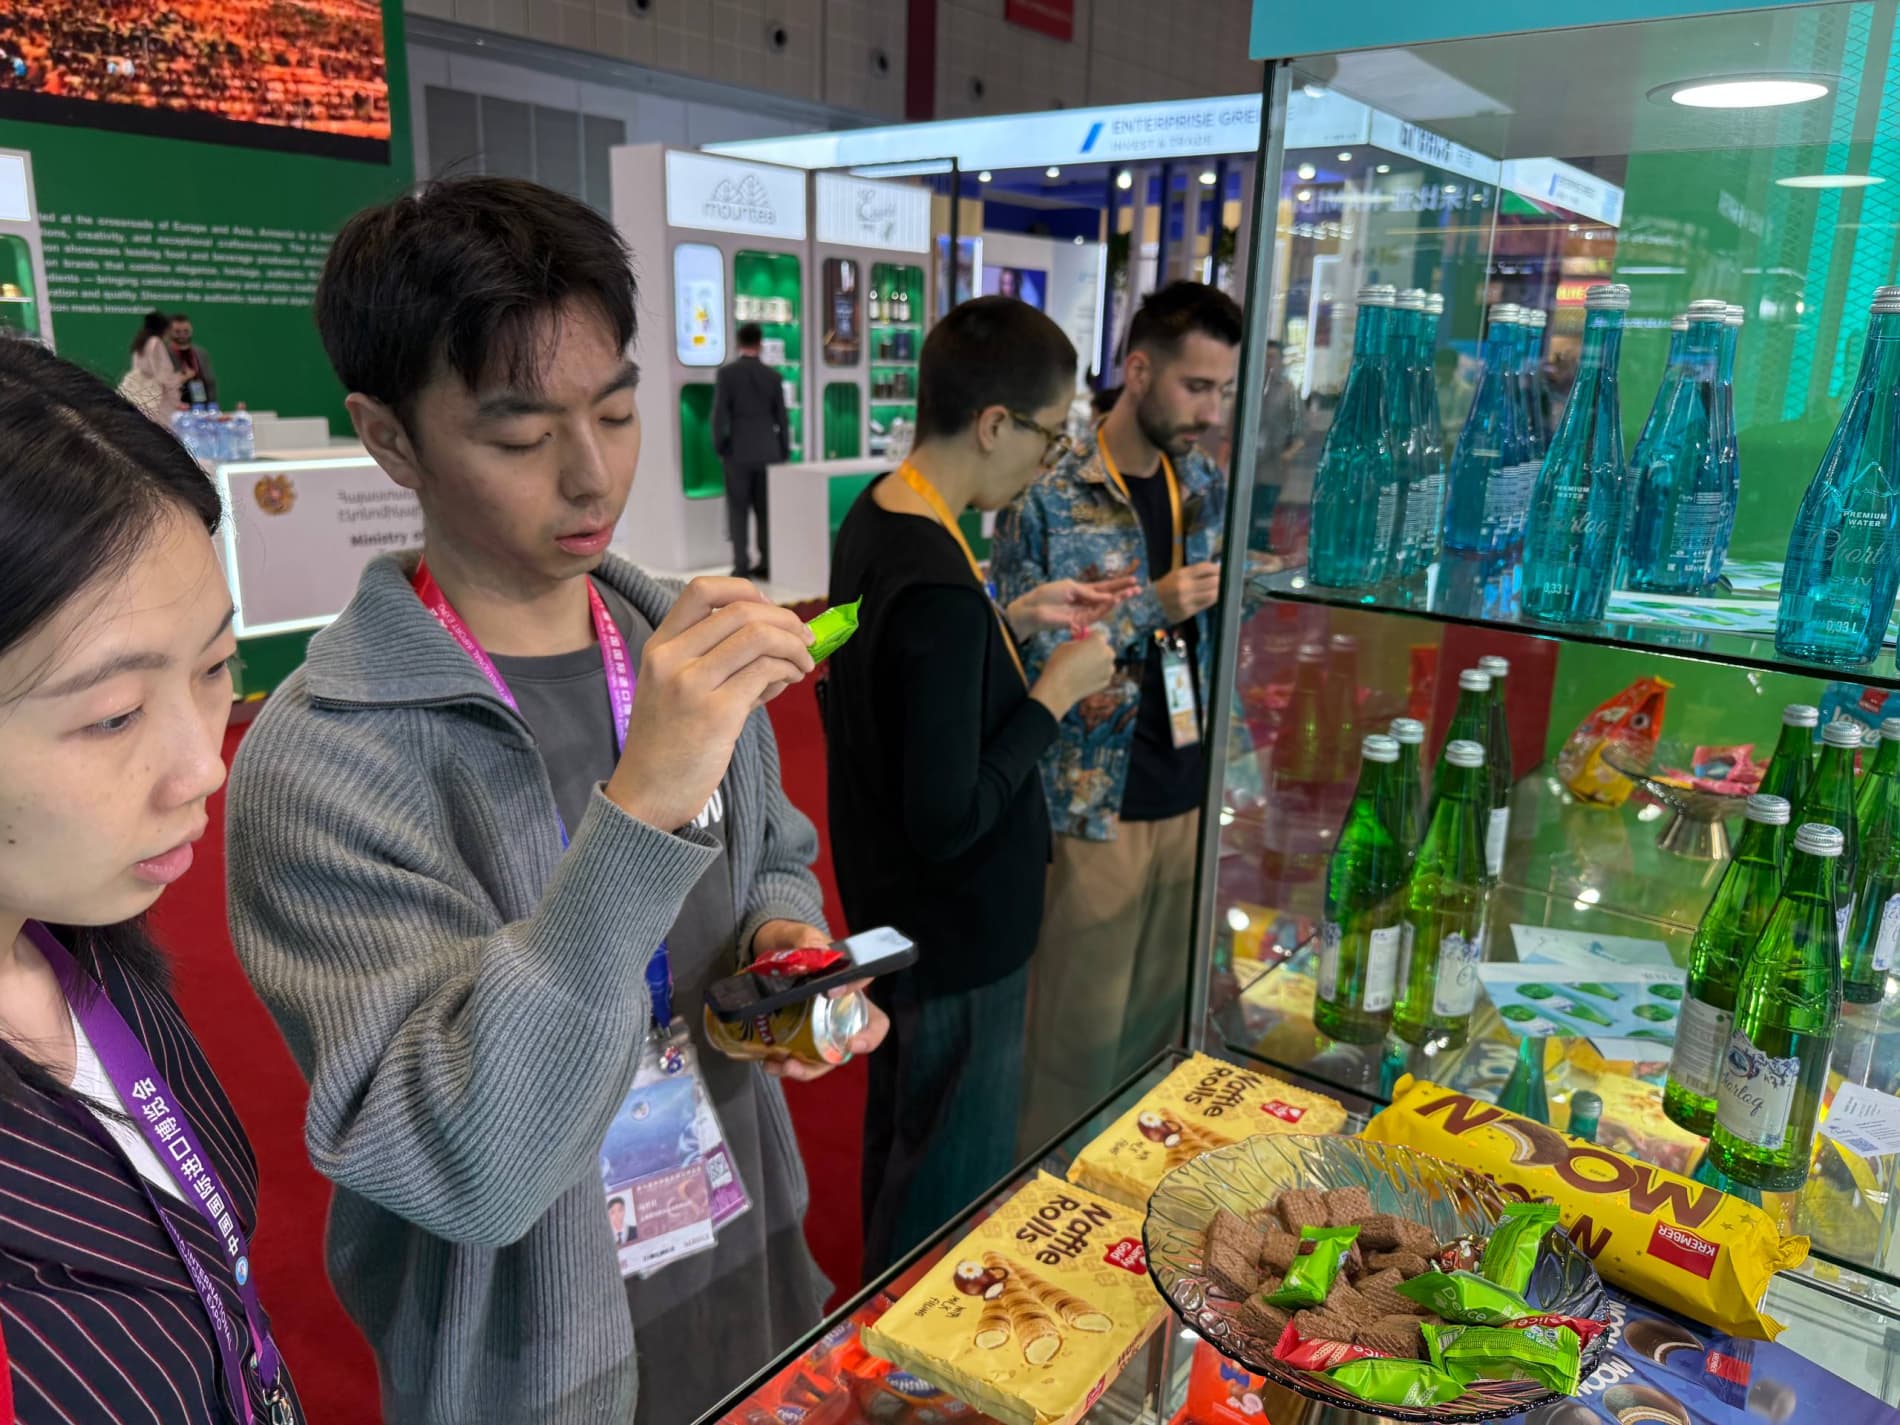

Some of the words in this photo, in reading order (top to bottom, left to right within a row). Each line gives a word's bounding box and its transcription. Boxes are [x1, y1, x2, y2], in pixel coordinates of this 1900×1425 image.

[1111, 112, 1214, 135] ENTERPRISE
[1554, 485, 1590, 493] PREMIUM
[1843, 511, 1888, 520] PREMIUM
[1848, 519, 1882, 528] WATER
[350, 532, 408, 548] Ministry
[1826, 620, 1850, 633] 0,33
[1851, 621, 1858, 634] L
[1184, 1066, 1234, 1106] Rolls
[131, 1076, 241, 1257] 中国国际进口博览会
[1015, 1193, 1081, 1243] Rolls
[1111, 1241, 1133, 1261] Gold
[1657, 1222, 1718, 1257] KREMBER
[185, 1249, 234, 1352] INTERNATIONAL
[206, 1294, 224, 1332] EXPO
